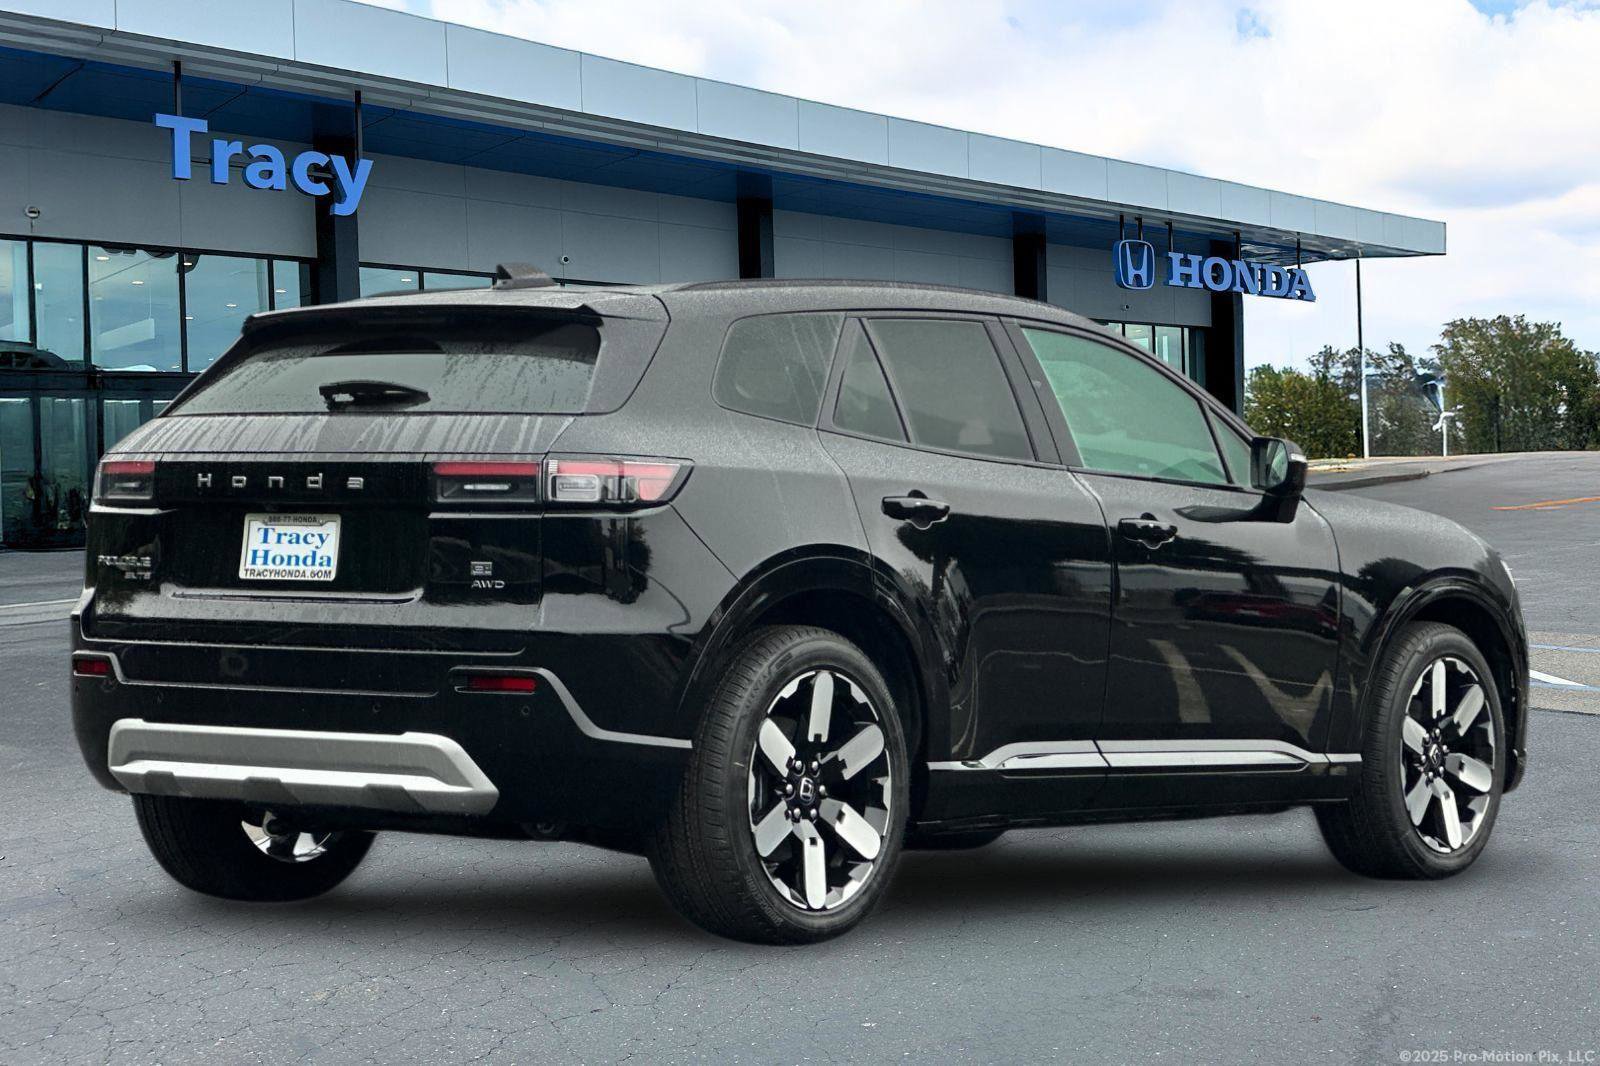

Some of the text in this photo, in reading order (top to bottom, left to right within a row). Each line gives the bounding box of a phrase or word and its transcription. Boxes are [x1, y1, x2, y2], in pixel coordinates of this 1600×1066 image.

[154, 113, 374, 216] Tracy
[1166, 251, 1316, 301] HONDA
[197, 472, 364, 490] Honda
[257, 527, 330, 549] Tracy
[250, 549, 332, 567] Honda
[244, 568, 332, 579] TRACYHONDA.COM
[471, 579, 505, 589] AWD
